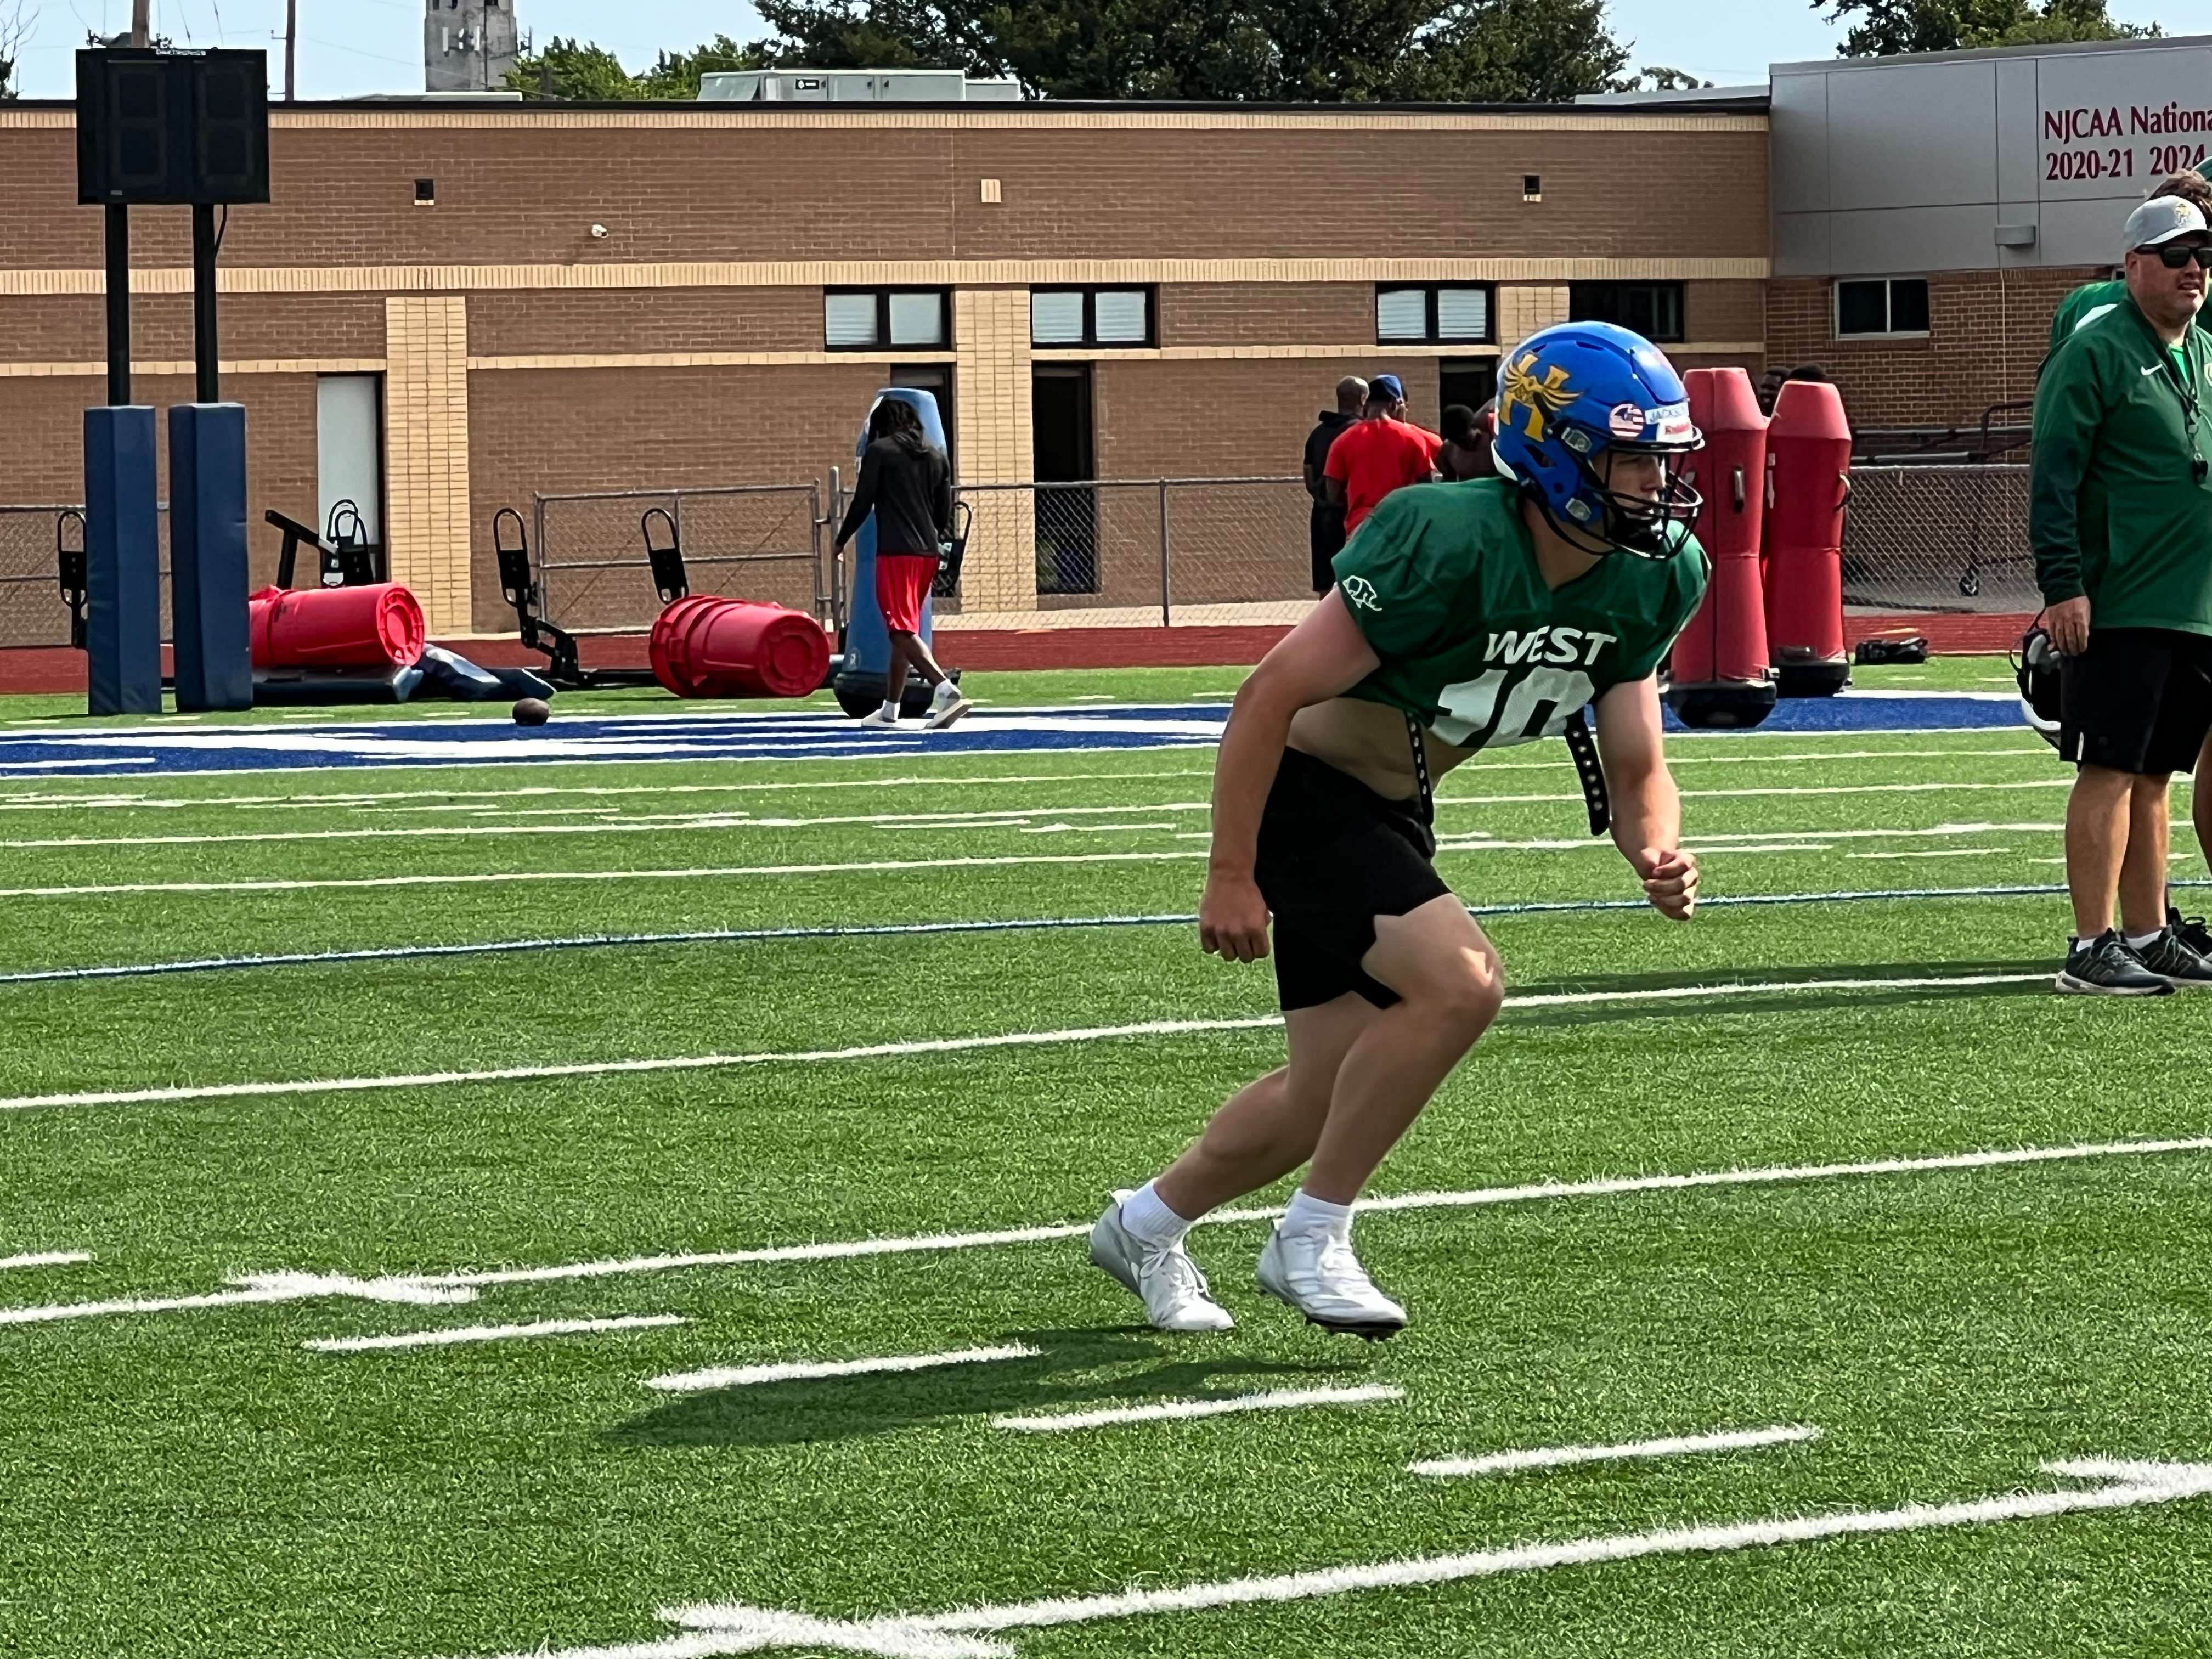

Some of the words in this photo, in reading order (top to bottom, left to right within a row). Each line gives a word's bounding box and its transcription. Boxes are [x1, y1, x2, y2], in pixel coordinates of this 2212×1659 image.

[2045, 106, 2123, 144] NJCAA
[2046, 148, 2132, 180] 2020-21
[1482, 625, 1617, 665] WEST
